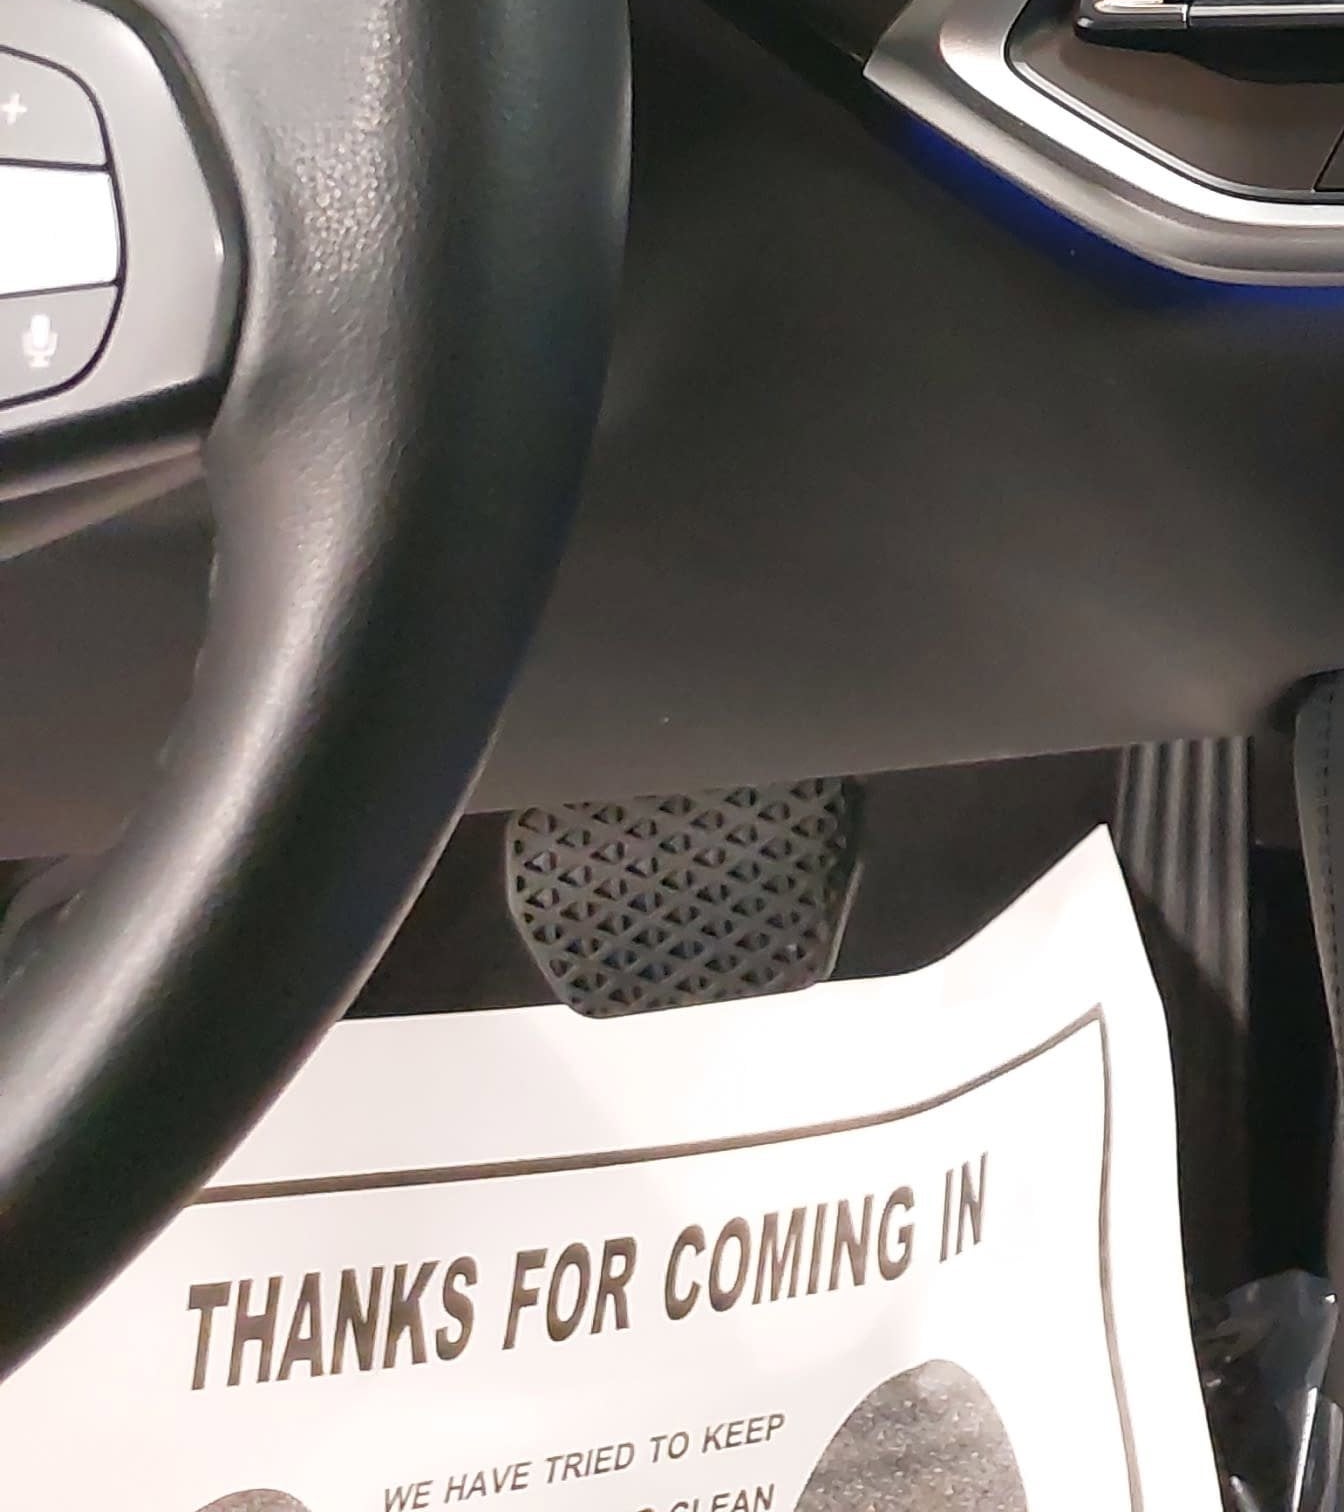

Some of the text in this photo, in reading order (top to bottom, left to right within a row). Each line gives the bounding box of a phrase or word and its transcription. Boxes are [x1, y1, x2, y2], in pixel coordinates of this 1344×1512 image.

[188, 1150, 988, 1391] THANKS FOR COMING IN
[382, 1413, 787, 1512] WE HAVE TRIED TO KEEP
